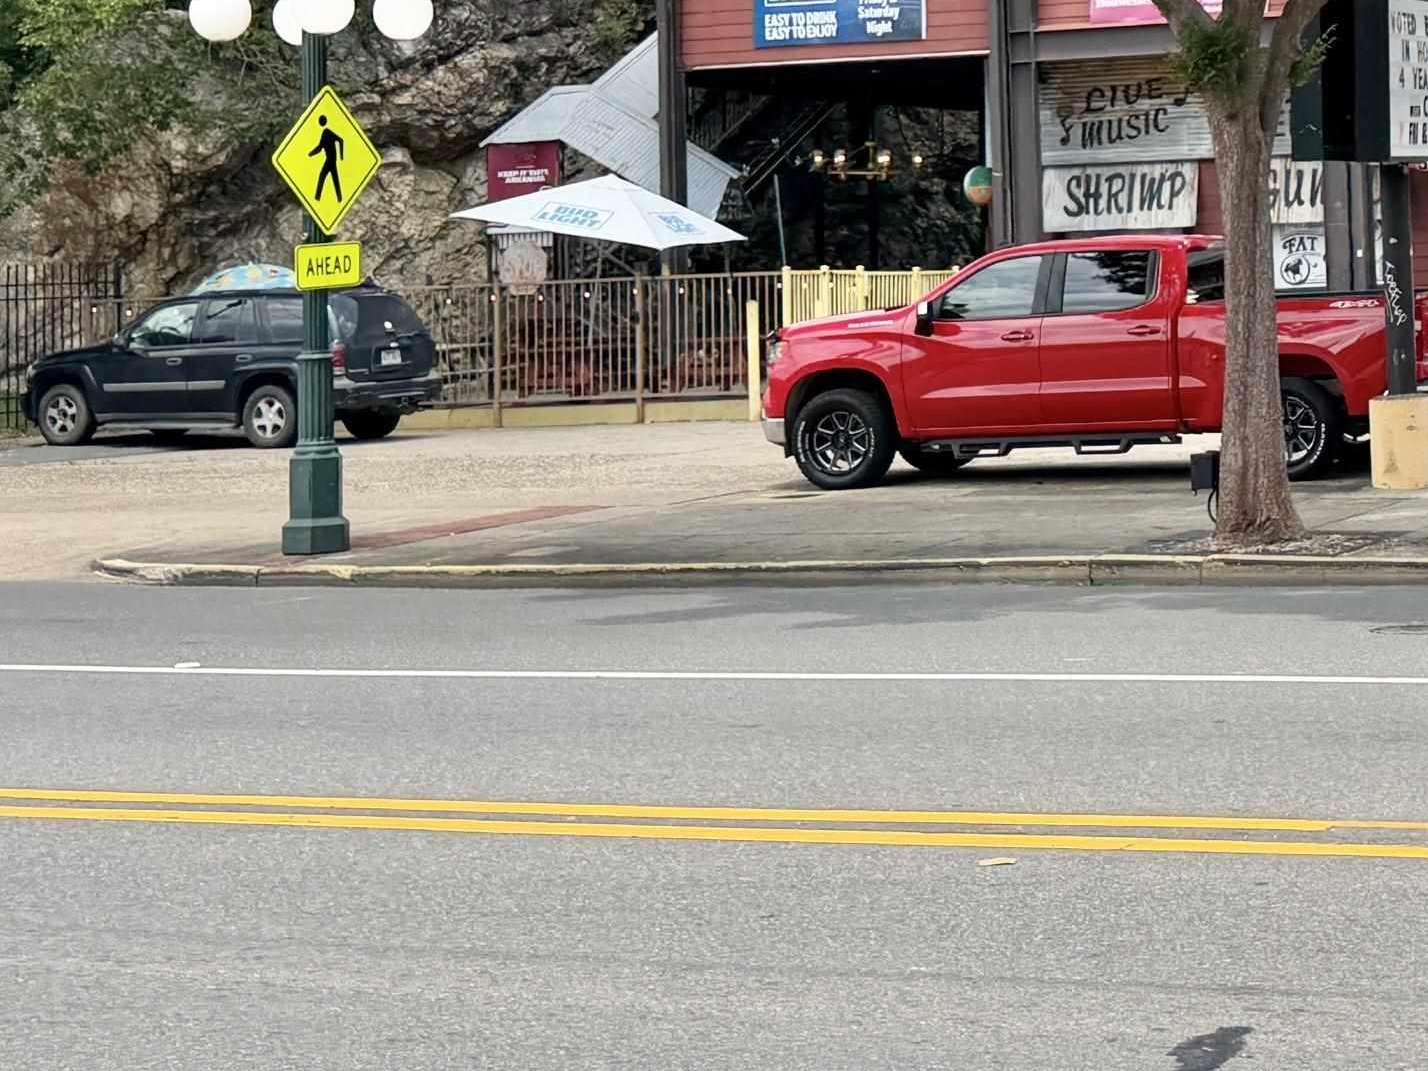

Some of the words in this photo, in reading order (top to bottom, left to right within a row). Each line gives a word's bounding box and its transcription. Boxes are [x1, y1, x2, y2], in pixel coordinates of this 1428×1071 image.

[765, 13, 791, 28] EASY
[791, 12, 806, 27] TO
[806, 10, 837, 26] DRINK
[858, 5, 900, 21] Saturday
[1391, 11, 1417, 35] VOTED
[765, 26, 791, 41] EASY
[791, 25, 806, 40] TO
[866, 20, 893, 37] Night
[1401, 40, 1411, 62] IN
[1399, 67, 1405, 89] 4
[1084, 78, 1164, 114] LIVE
[1080, 107, 1170, 150] MUSIC
[1063, 169, 1188, 217] SHRIMP
[537, 211, 603, 228] LIGHT
[555, 205, 600, 219] BUD
[1282, 235, 1319, 254] FAT
[306, 255, 352, 277] AHEAD
